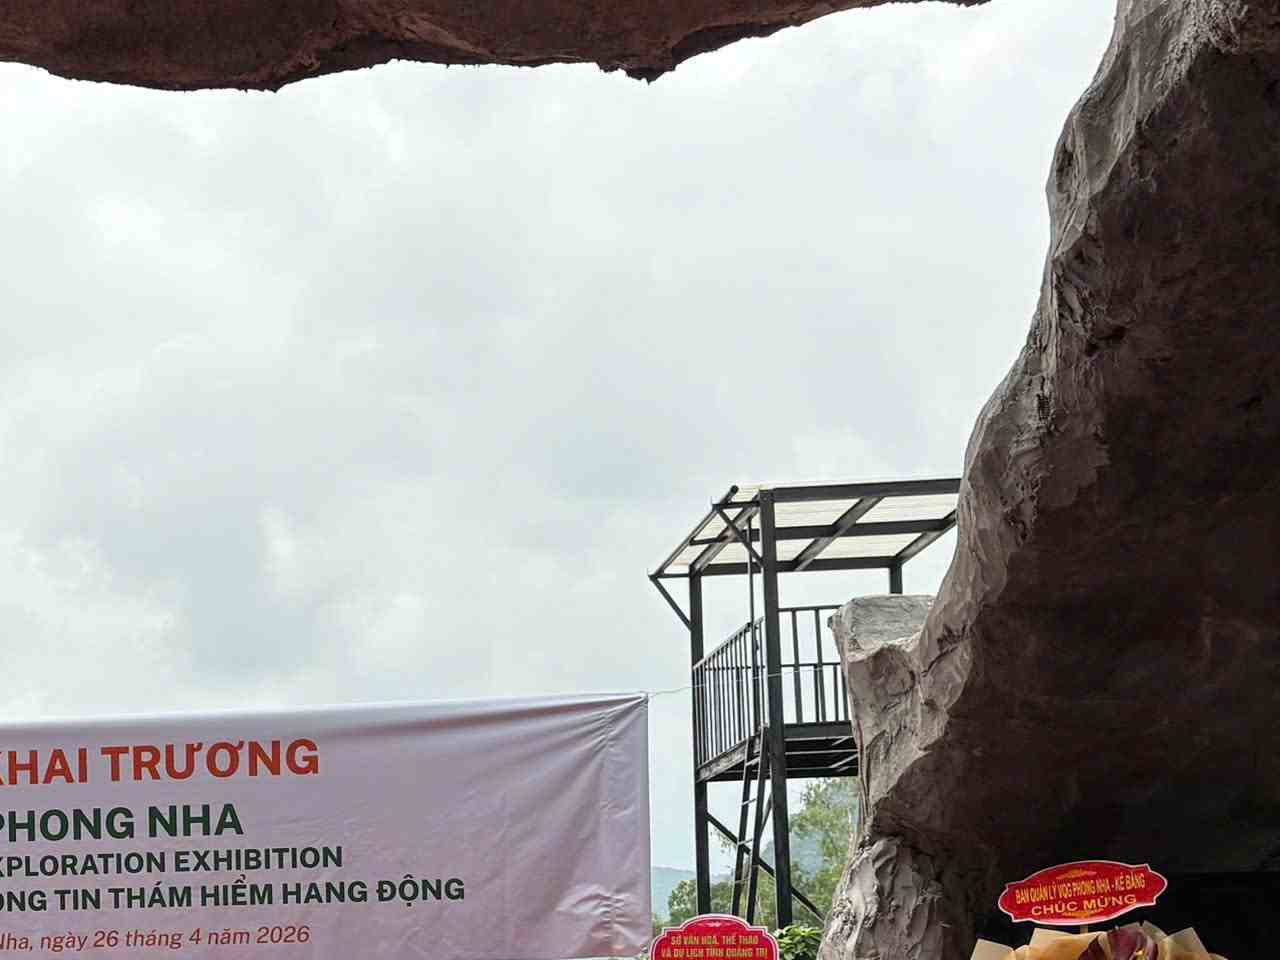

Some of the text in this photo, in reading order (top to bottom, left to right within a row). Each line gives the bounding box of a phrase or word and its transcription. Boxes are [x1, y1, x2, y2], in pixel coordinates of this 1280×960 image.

[100, 738, 320, 782] TRƯƠNG
[148, 803, 245, 838] NHA
[175, 845, 343, 873] EXHIBITION
[54, 887, 102, 911] TIN
[108, 880, 193, 909] THÁM
[200, 873, 274, 907] HIỂM
[281, 880, 369, 905] HANG
[376, 873, 465, 908] ĐỘNG
[1072, 880, 1096, 896] PHONG
[1096, 876, 1111, 893] NHA
[1031, 893, 1137, 916] CHÚC MỪNG
[39, 931, 89, 953] ngày
[93, 929, 120, 949] 26
[125, 928, 184, 950] tháng
[188, 927, 202, 945] 4
[207, 928, 251, 945] năm
[255, 925, 311, 945] 2026
